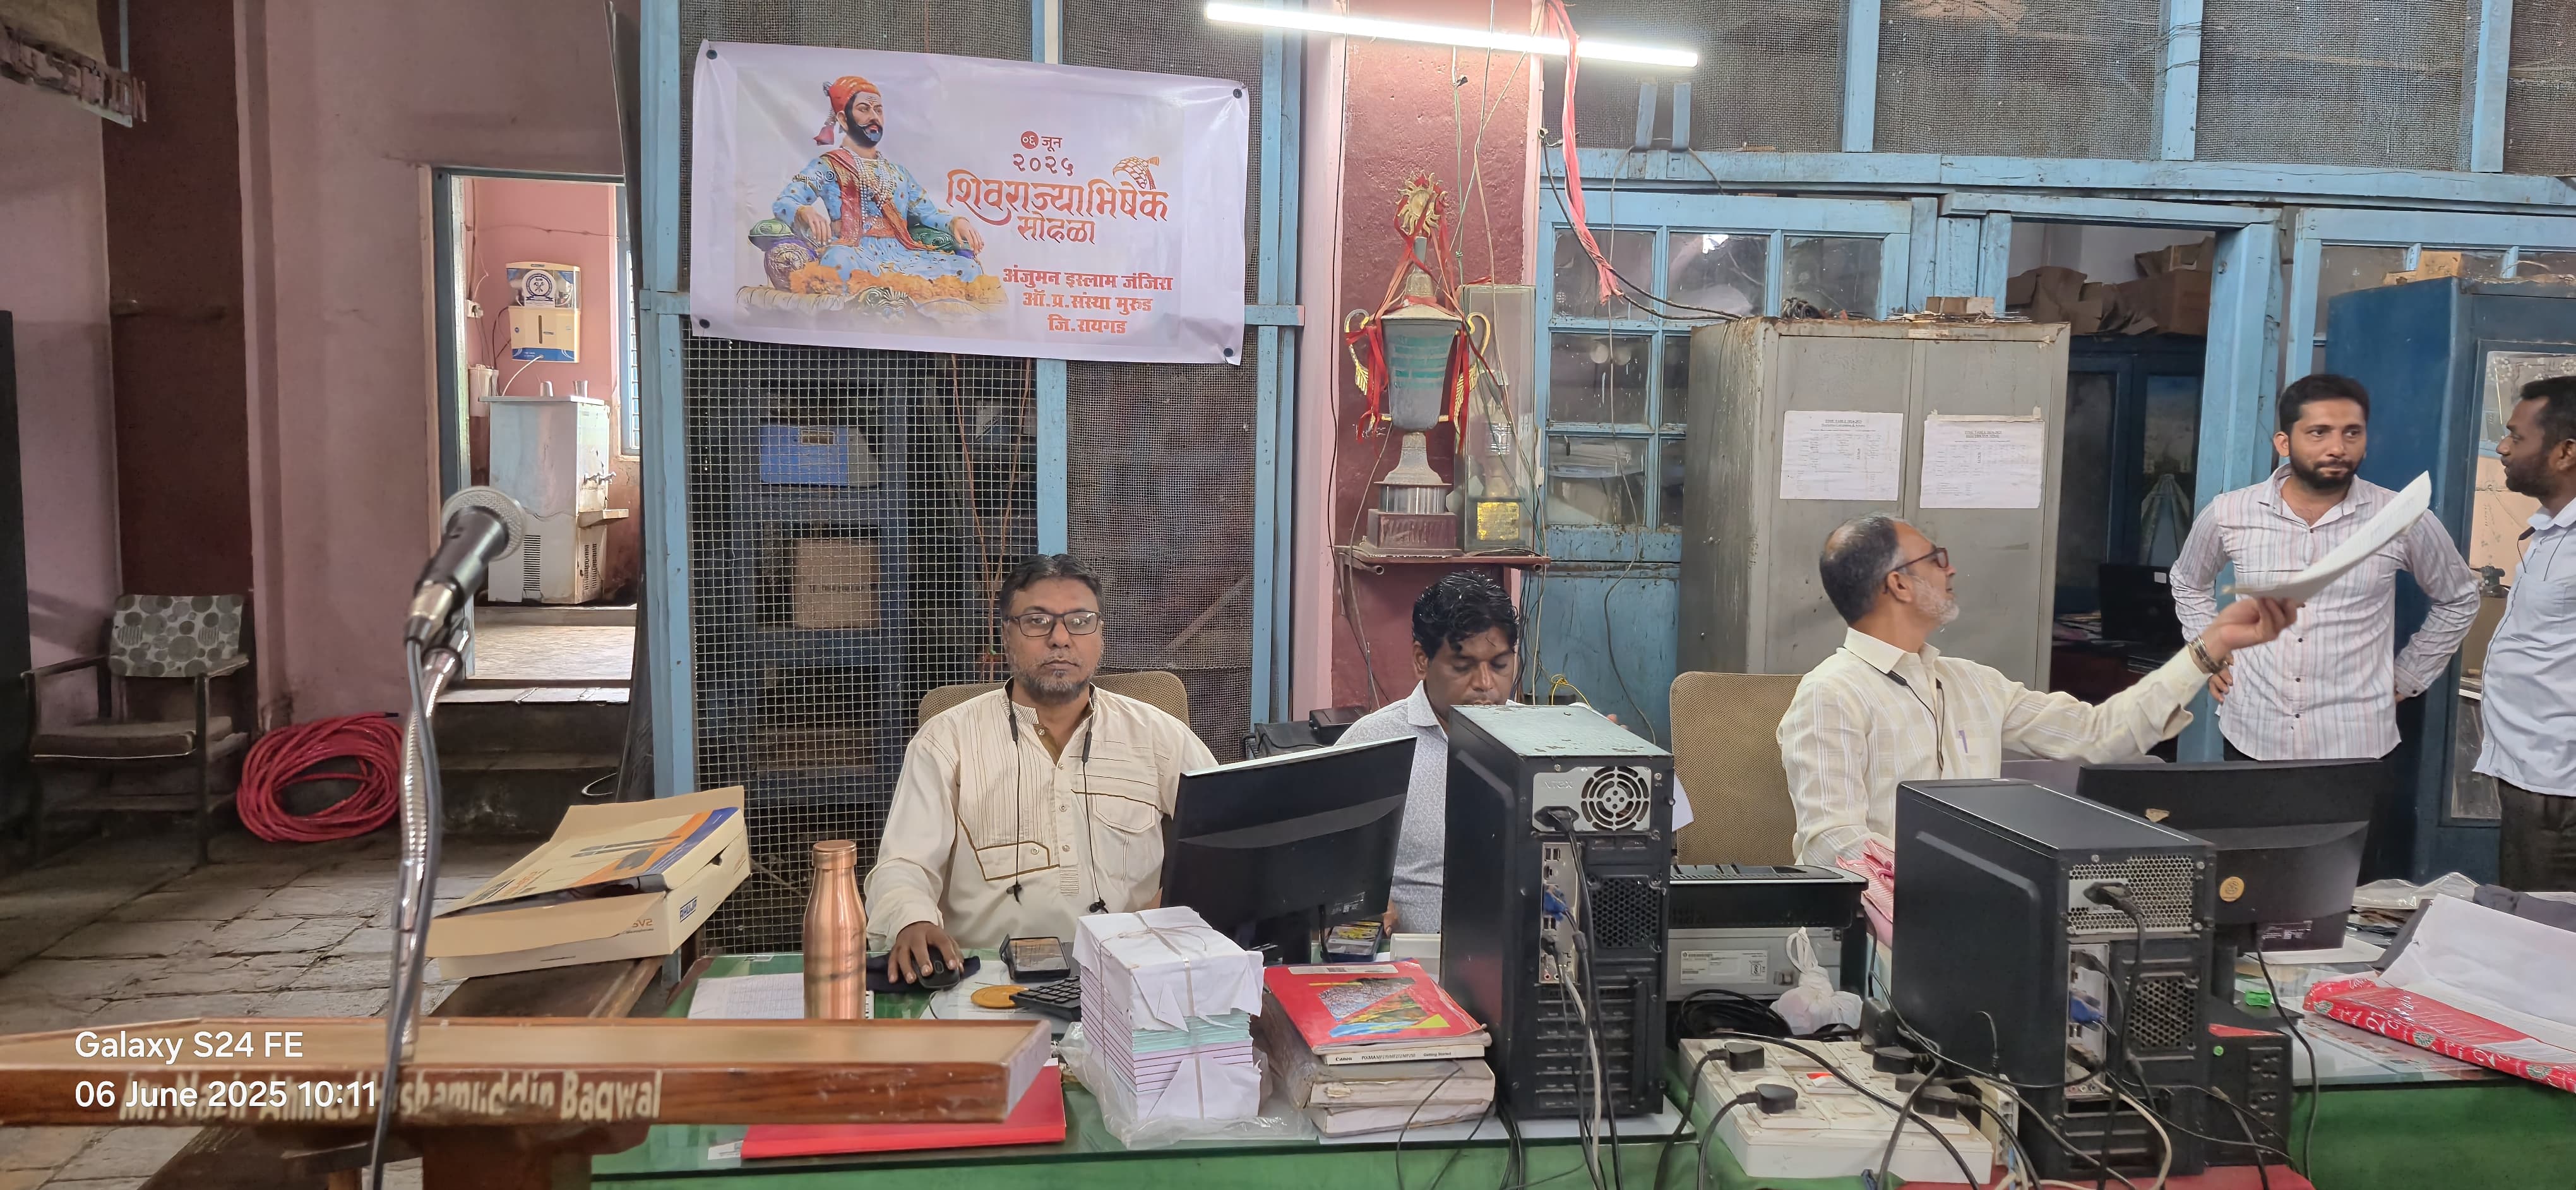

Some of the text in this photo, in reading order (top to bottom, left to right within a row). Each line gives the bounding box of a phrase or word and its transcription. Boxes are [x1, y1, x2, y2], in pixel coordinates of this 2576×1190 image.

[1041, 136, 1063, 152] जून
[1013, 153, 1074, 177] २०२५
[946, 169, 1169, 226] शिवराज्याभिषेक
[1003, 265, 1174, 291] अंजुमन इस्लाम जंजिरा
